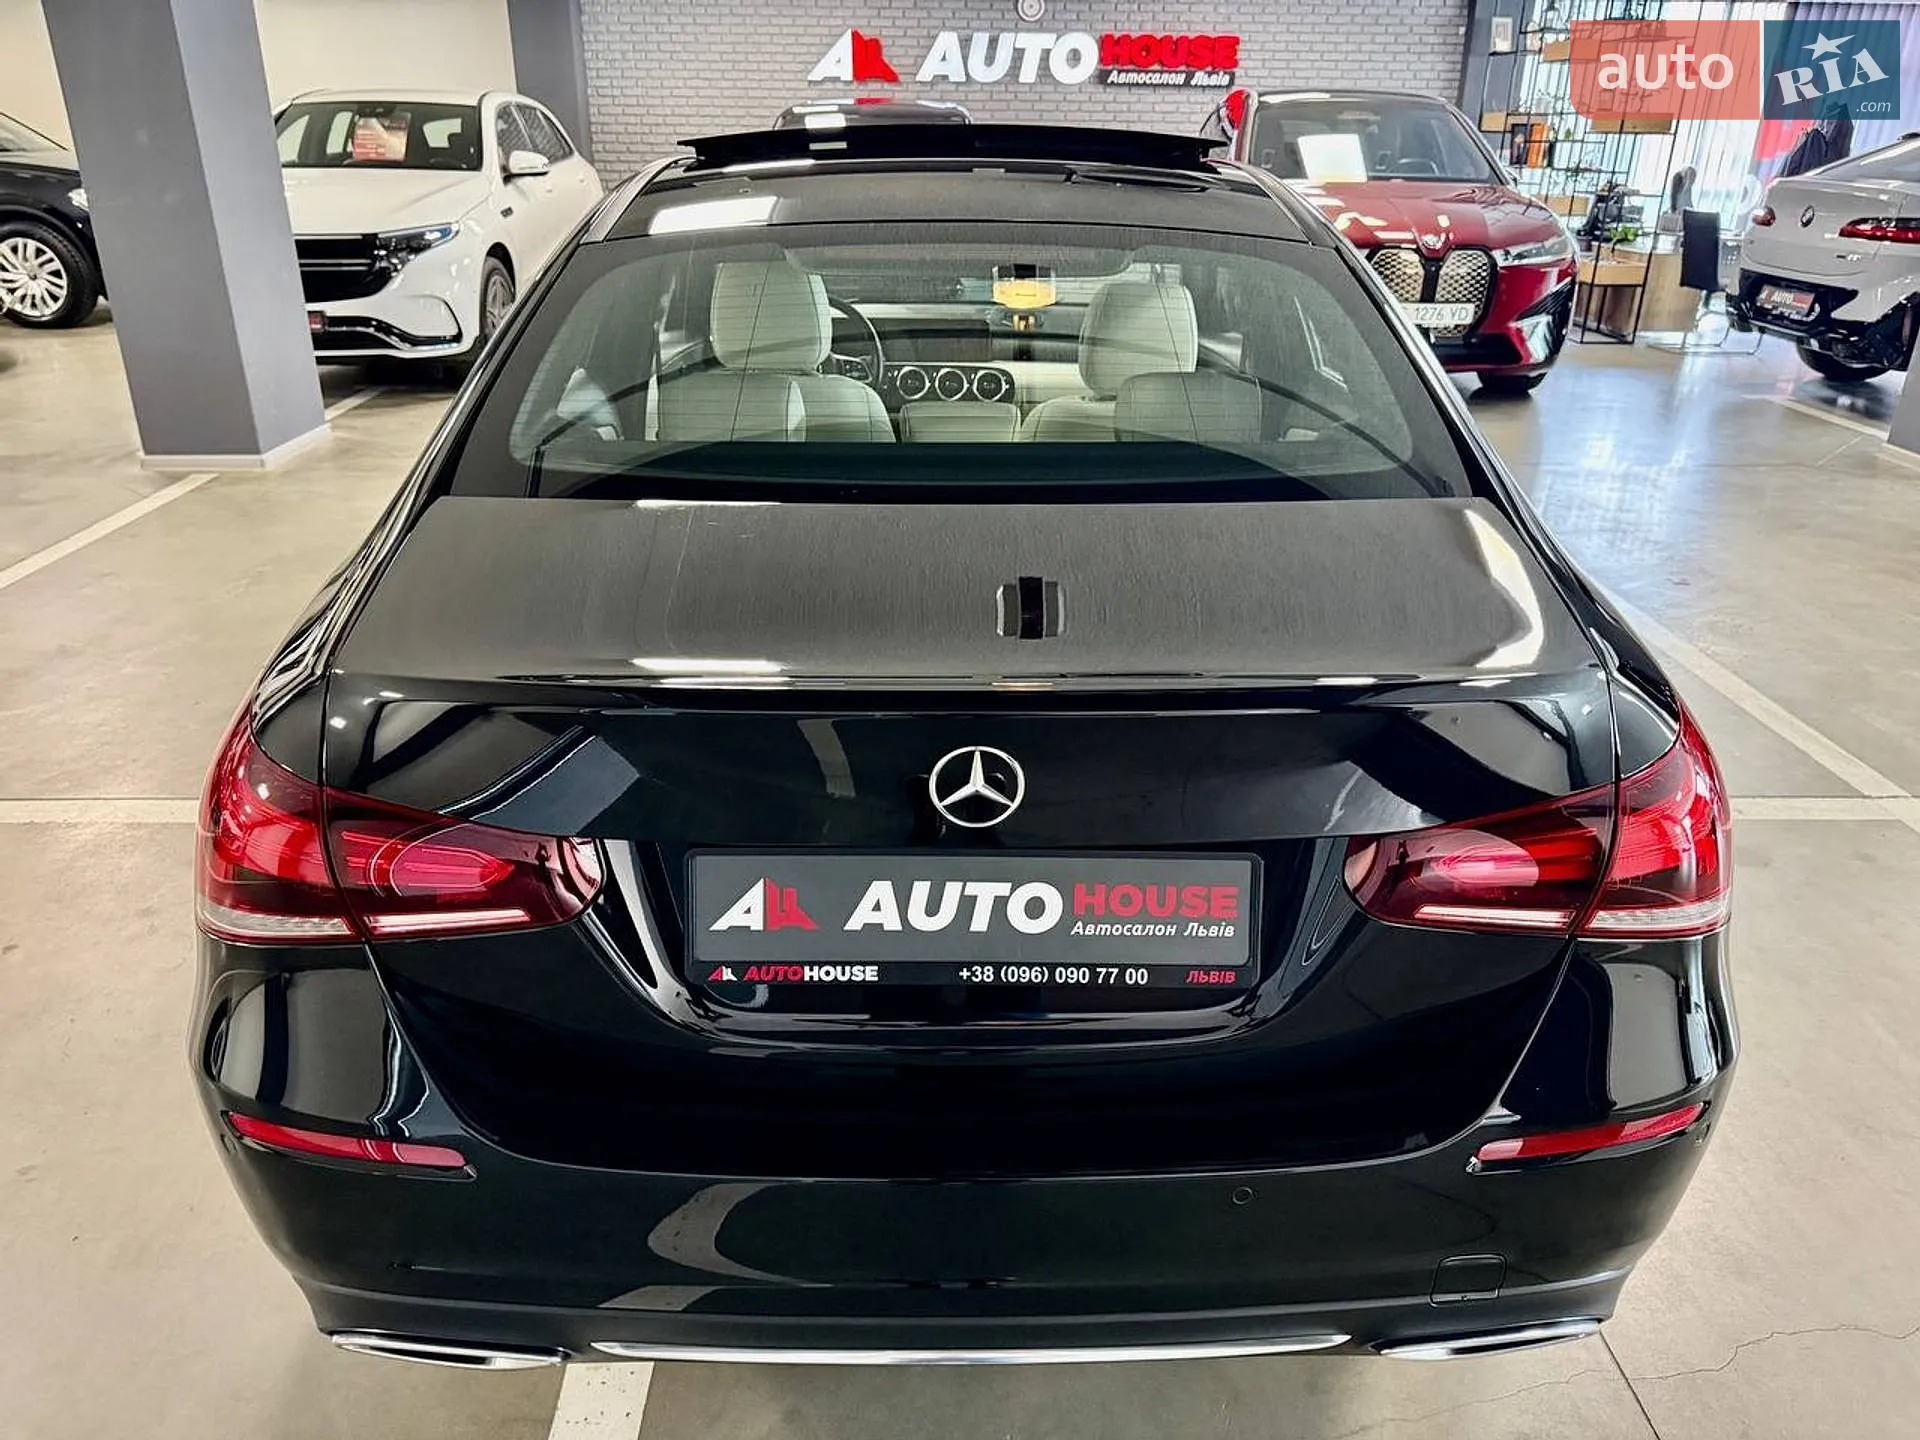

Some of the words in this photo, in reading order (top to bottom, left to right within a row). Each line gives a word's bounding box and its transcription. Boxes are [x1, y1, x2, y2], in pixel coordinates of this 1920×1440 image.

[916, 31, 1099, 84] AUTO
[1101, 33, 1240, 68] HOUSE
[1107, 69, 1185, 86] Автосалон
[1415, 306, 1445, 321] 1276
[843, 880, 1064, 934] AUTO
[1073, 883, 1239, 918] HOUSE
[1071, 921, 1177, 937] Автосалон
[1183, 922, 1235, 937] Львів
[743, 965, 879, 982] AUTOHOUSE
[959, 966, 994, 983] +38
[1001, 966, 1049, 984] (096)
[1055, 967, 1090, 984] 090
[1096, 968, 1117, 984] 77
[1125, 969, 1148, 985] 00
